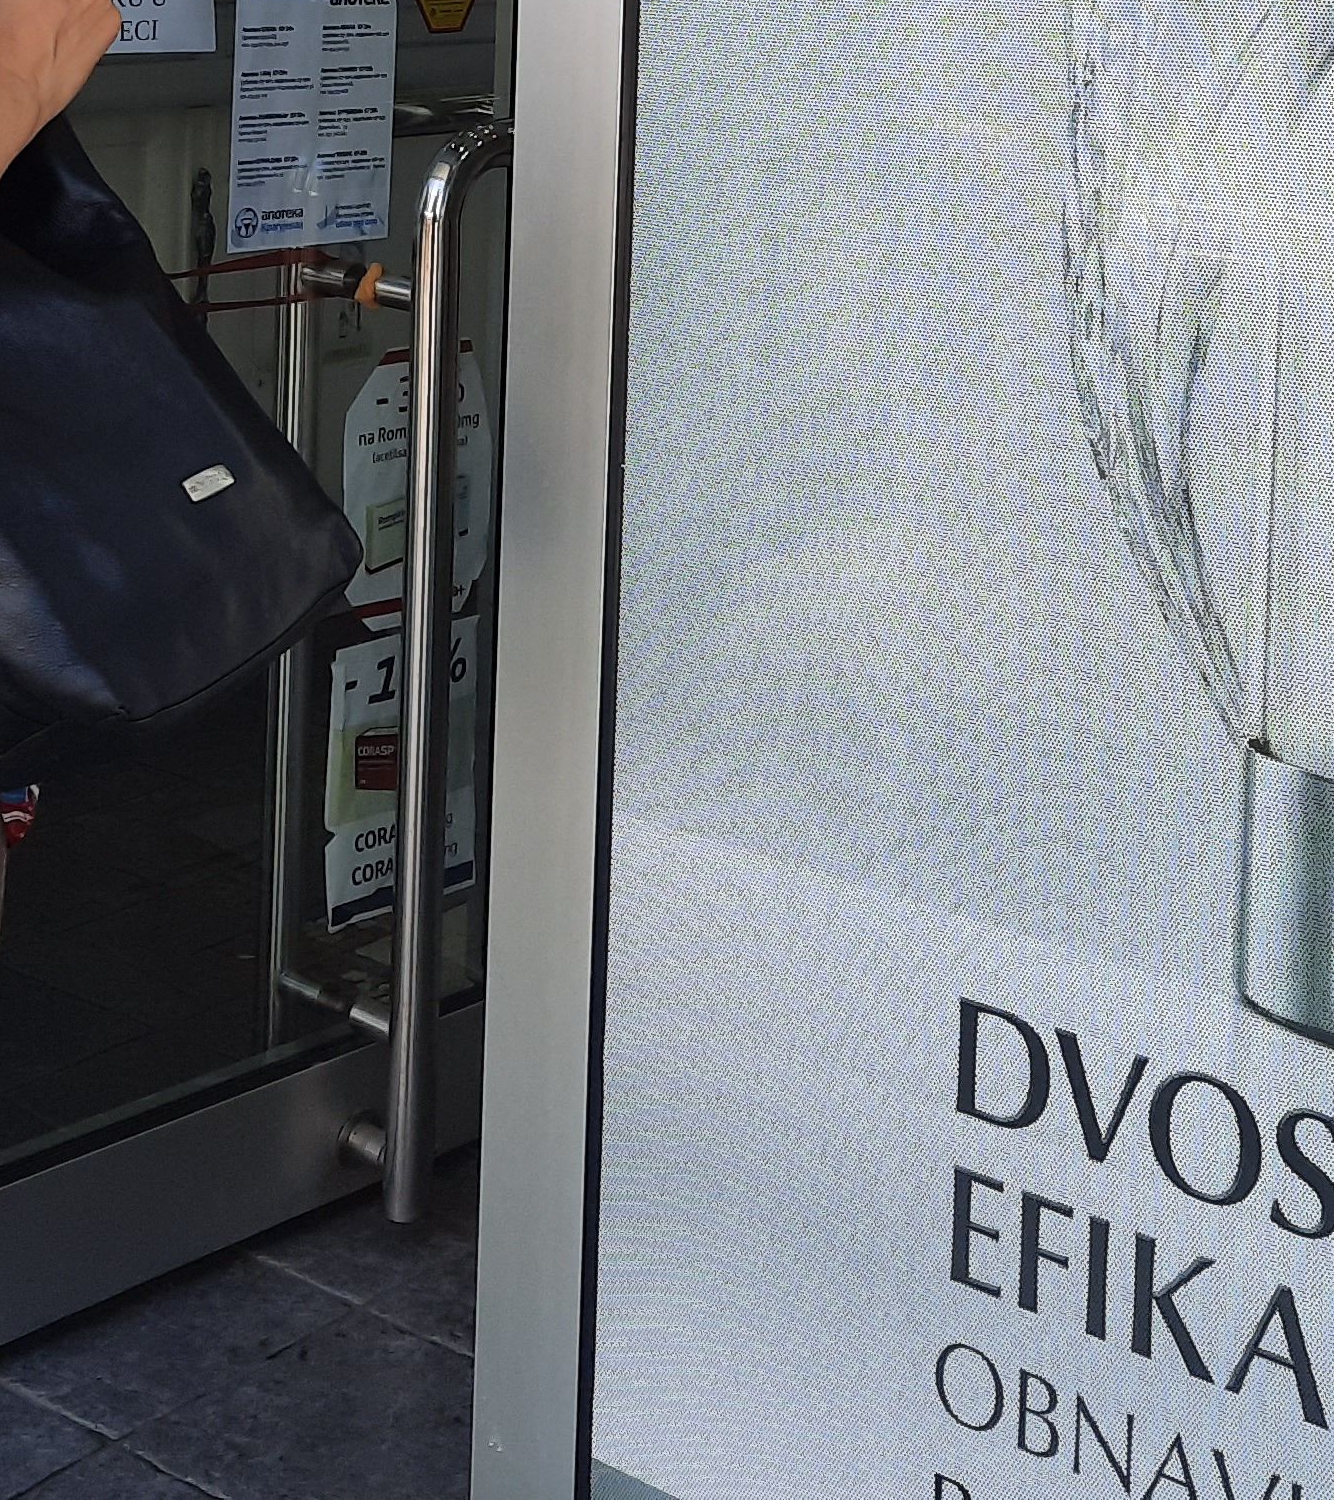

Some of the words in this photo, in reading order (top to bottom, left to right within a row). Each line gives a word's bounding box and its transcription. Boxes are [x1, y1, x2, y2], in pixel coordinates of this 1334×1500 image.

[261, 208, 304, 221] апотека
[359, 430, 375, 447] na
[354, 822, 397, 854] CORA
[351, 856, 394, 887] CORA
